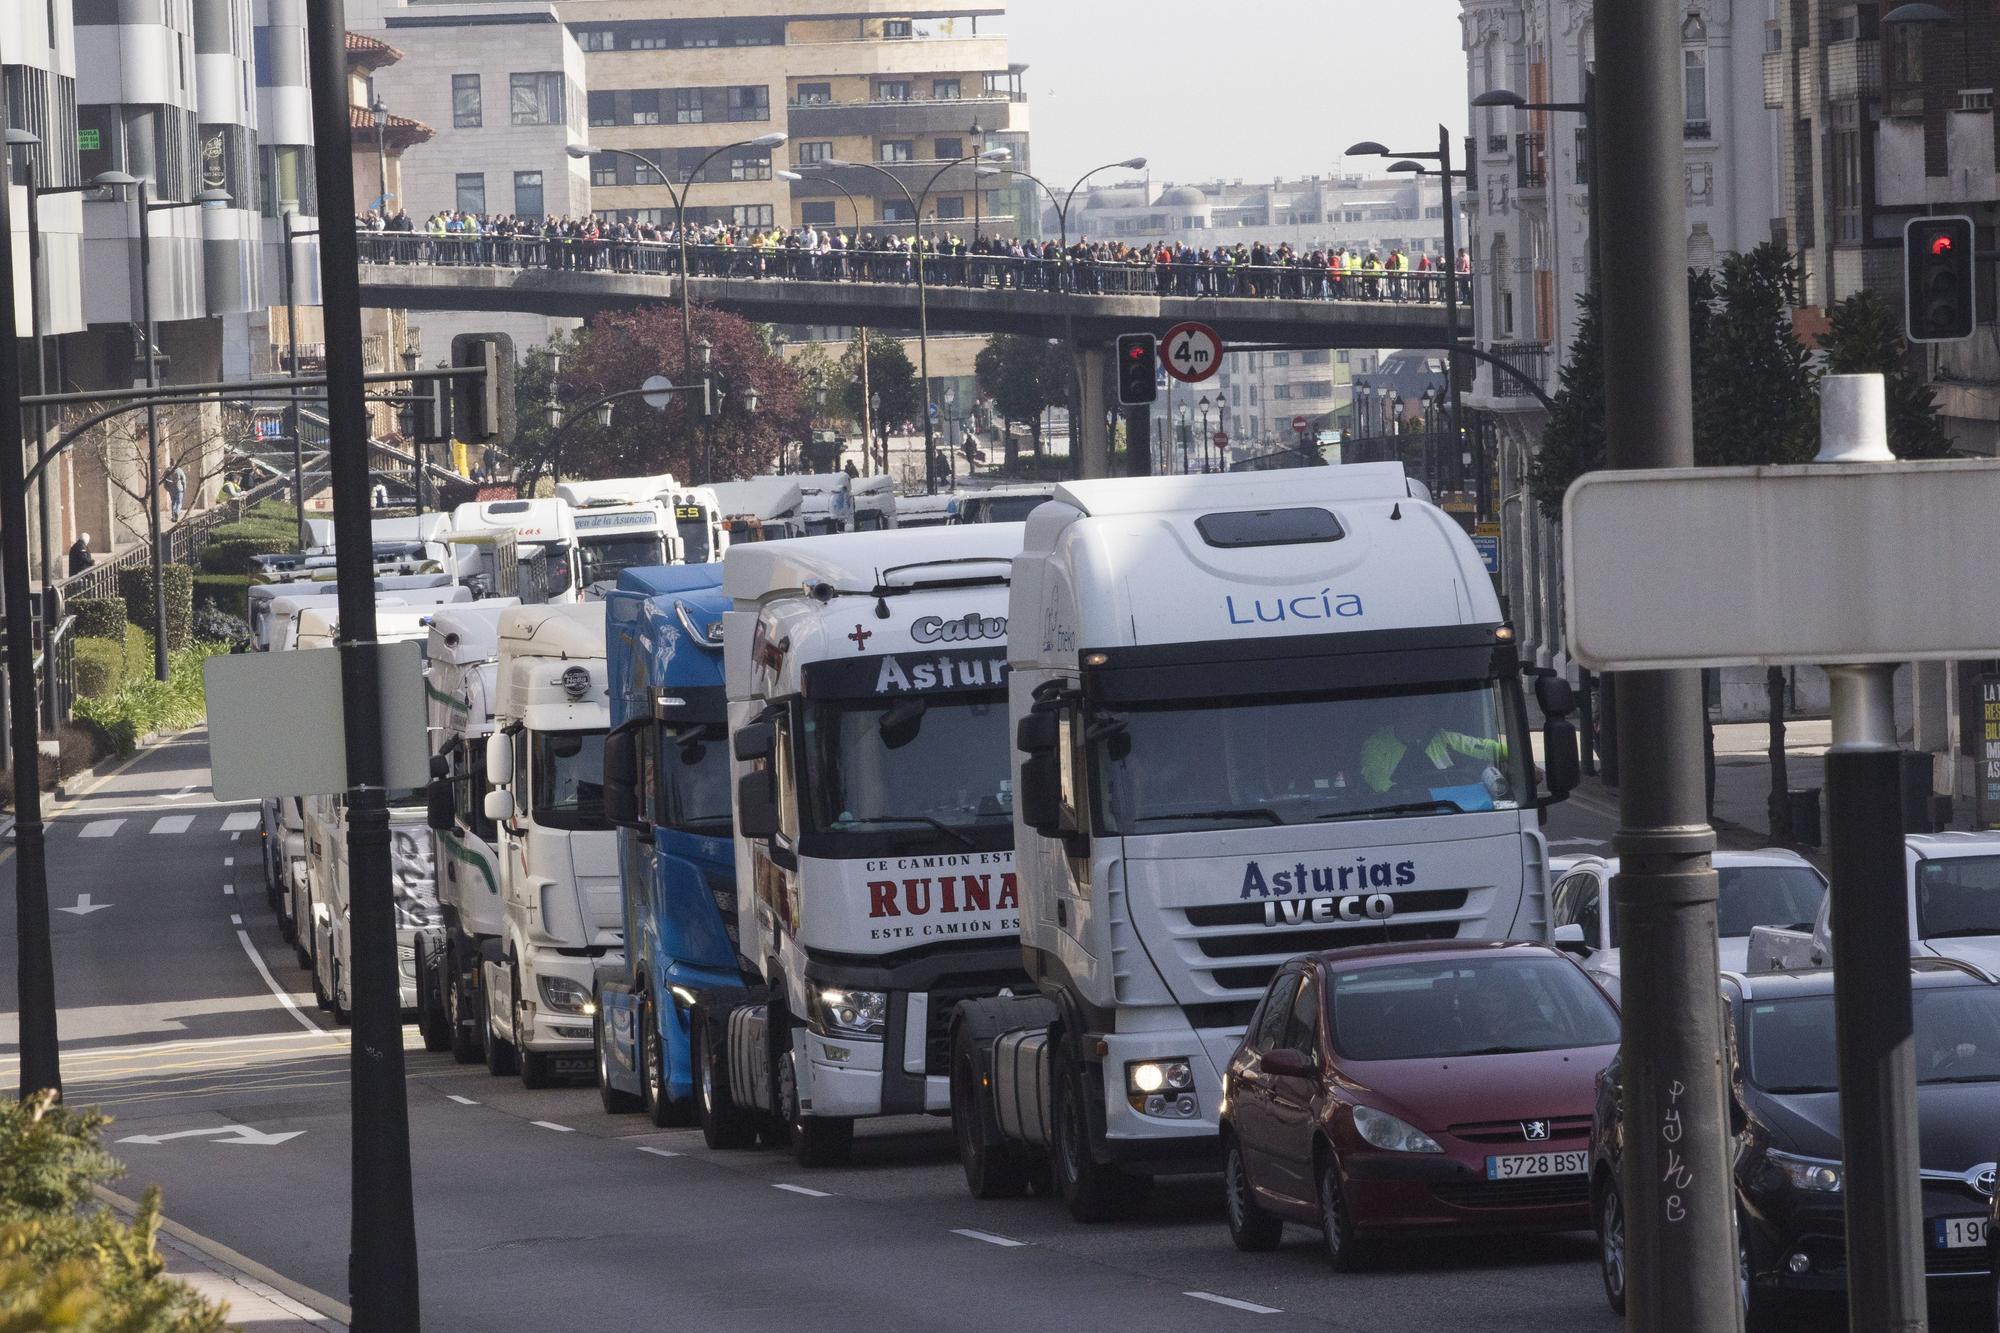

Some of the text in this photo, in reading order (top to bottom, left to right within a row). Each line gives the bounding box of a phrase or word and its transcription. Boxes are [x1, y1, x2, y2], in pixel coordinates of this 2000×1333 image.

[575, 518, 590, 529] gen
[1226, 587, 1363, 625] Lucía
[910, 612, 1008, 644] Calv
[1983, 684, 1995, 701] LA
[866, 852, 1013, 872] CE CAMION EST
[1240, 856, 1416, 900] Asturias
[866, 872, 1019, 918] RUINA
[1264, 893, 1394, 927] IVECO
[871, 926, 914, 940] ESTE
[923, 919, 991, 936] CAMIÓN
[1502, 1156, 1549, 1176] 5728
[1554, 1152, 1587, 1172] BSY
